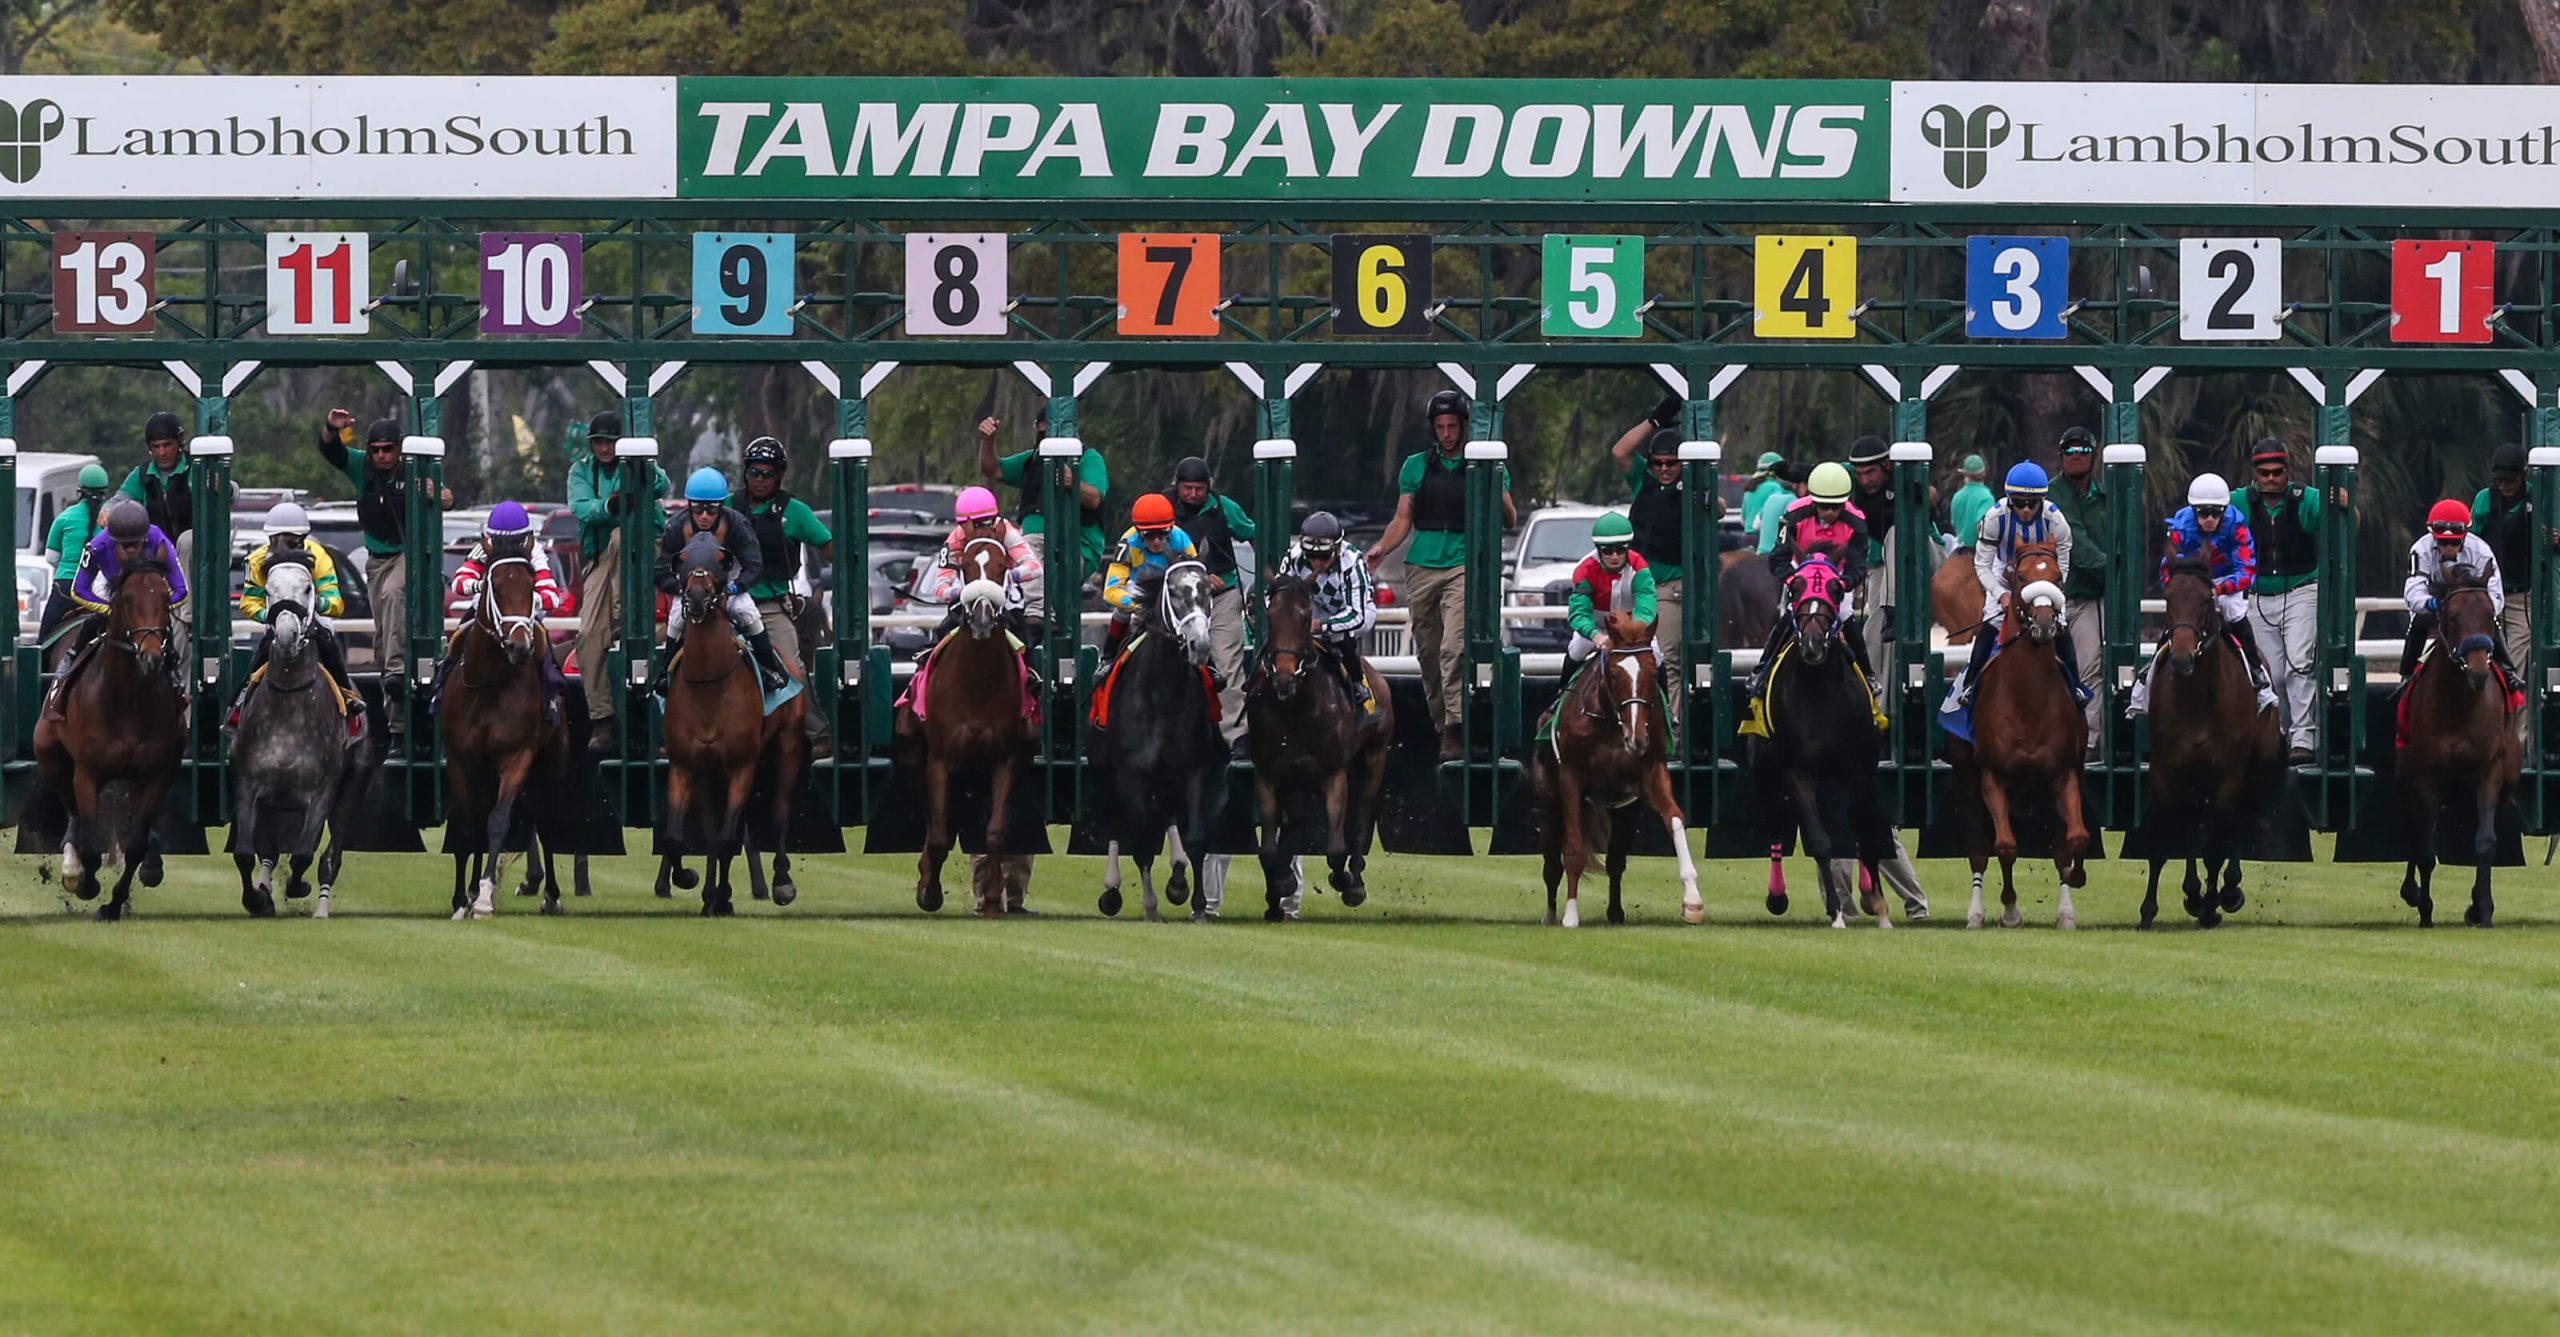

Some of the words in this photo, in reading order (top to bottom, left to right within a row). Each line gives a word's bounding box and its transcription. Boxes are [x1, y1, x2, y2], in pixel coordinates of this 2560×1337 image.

[73, 114, 636, 156] LambholmSouth
[698, 102, 1114, 177] TAMPA
[1142, 103, 1402, 177] BAY
[1411, 104, 1866, 178] DOWNS
[60, 241, 148, 325] 13
[278, 243, 351, 324] 11
[487, 243, 571, 327] 10
[719, 244, 768, 326] 9
[932, 244, 980, 326] 8
[1145, 247, 1193, 325] 7
[1356, 245, 1406, 328] 6
[1567, 247, 1616, 328] 5
[1780, 248, 1830, 328] 4
[1991, 247, 2041, 330] 3
[2207, 249, 2255, 329] 2
[2425, 251, 2461, 333] 1
[939, 547, 948, 567] 8
[1116, 543, 1127, 562] 7
[1279, 558, 1289, 573] 6
[1779, 525, 1788, 544] 4
